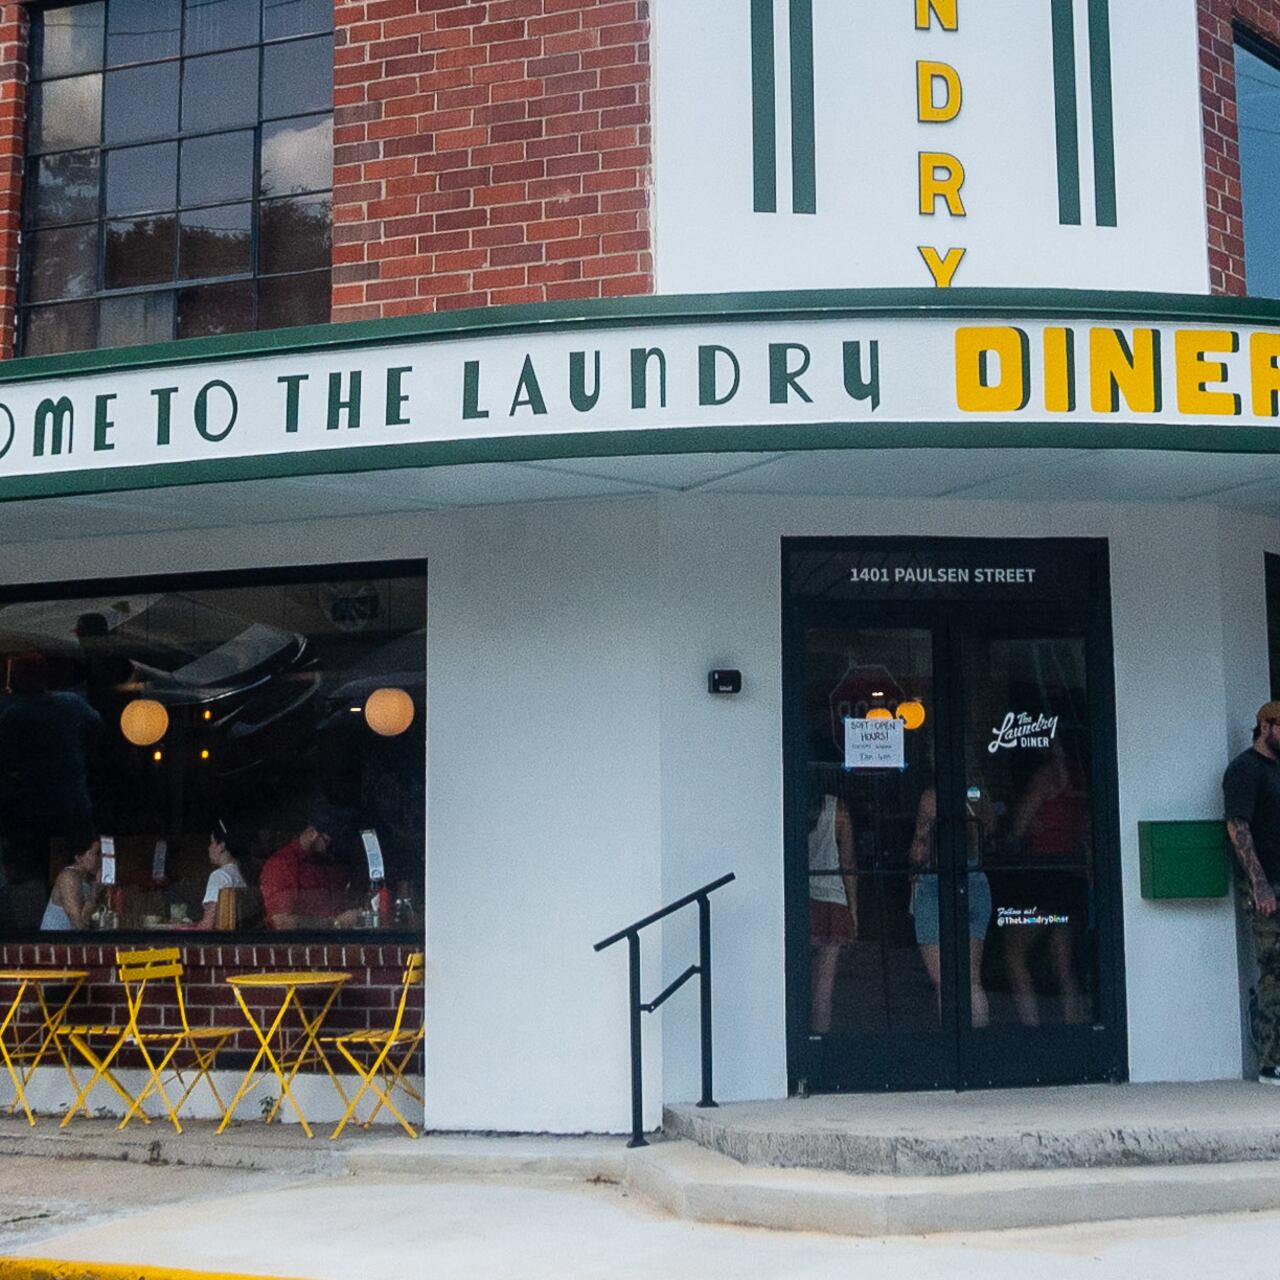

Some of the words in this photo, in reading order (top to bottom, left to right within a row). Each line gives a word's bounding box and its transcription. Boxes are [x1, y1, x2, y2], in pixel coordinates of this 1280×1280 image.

[150, 379, 238, 446] TO
[277, 366, 413, 433] THE
[462, 340, 880, 420] LAUNDRY
[850, 568, 890, 582] 1401
[894, 568, 969, 583] PAULSEN
[974, 568, 1036, 583] STREET
[1017, 712, 1032, 725] The
[988, 712, 1058, 753] Laundry
[1020, 736, 1050, 748] DINER
